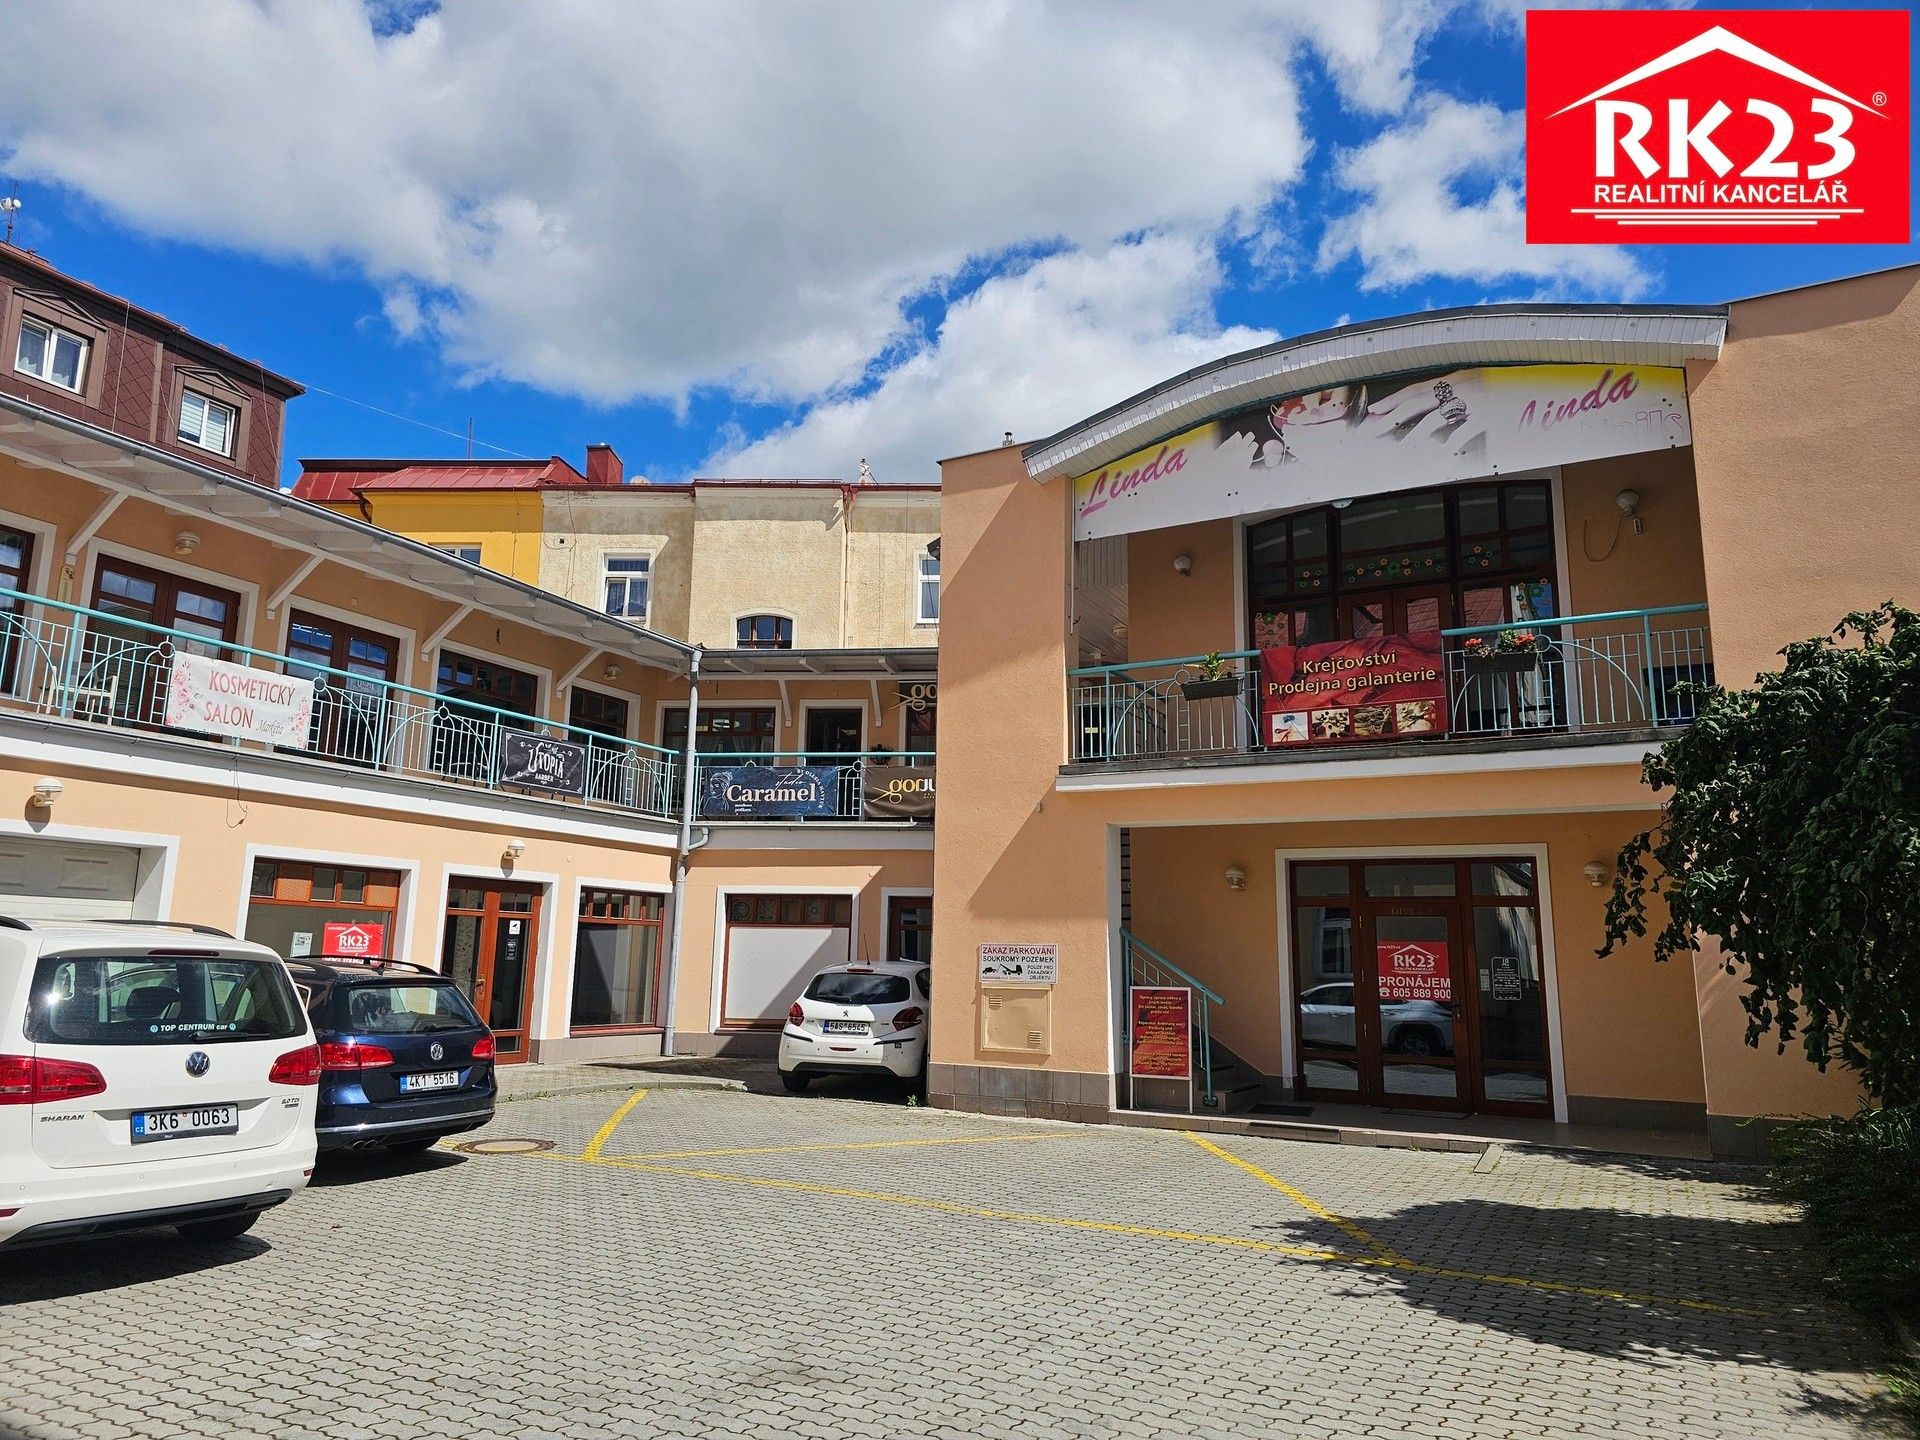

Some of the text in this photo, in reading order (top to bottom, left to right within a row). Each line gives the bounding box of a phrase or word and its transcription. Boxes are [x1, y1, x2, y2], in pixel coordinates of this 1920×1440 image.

[1080, 445, 1187, 520] Linda
[1302, 649, 1396, 675] Krejčovství
[208, 669, 296, 706] KOSMETICKÝ
[1269, 667, 1436, 696] Prodejna galanterie
[203, 700, 255, 729] SALON
[726, 783, 817, 802] Caramel
[339, 935, 369, 947] RK23
[1394, 955, 1435, 968] RK23
[1378, 975, 1451, 988] PRONÁJEM
[1393, 988, 1451, 998] 605 889 900
[161, 1024, 176, 1032] TOP
[178, 1023, 215, 1031] CENTRUM
[410, 1075, 426, 1087] 4K1
[433, 1072, 454, 1085] 5516
[40, 1114, 85, 1123] SHARAN
[149, 1113, 179, 1131] 3K6
[192, 1108, 230, 1126] 0063
